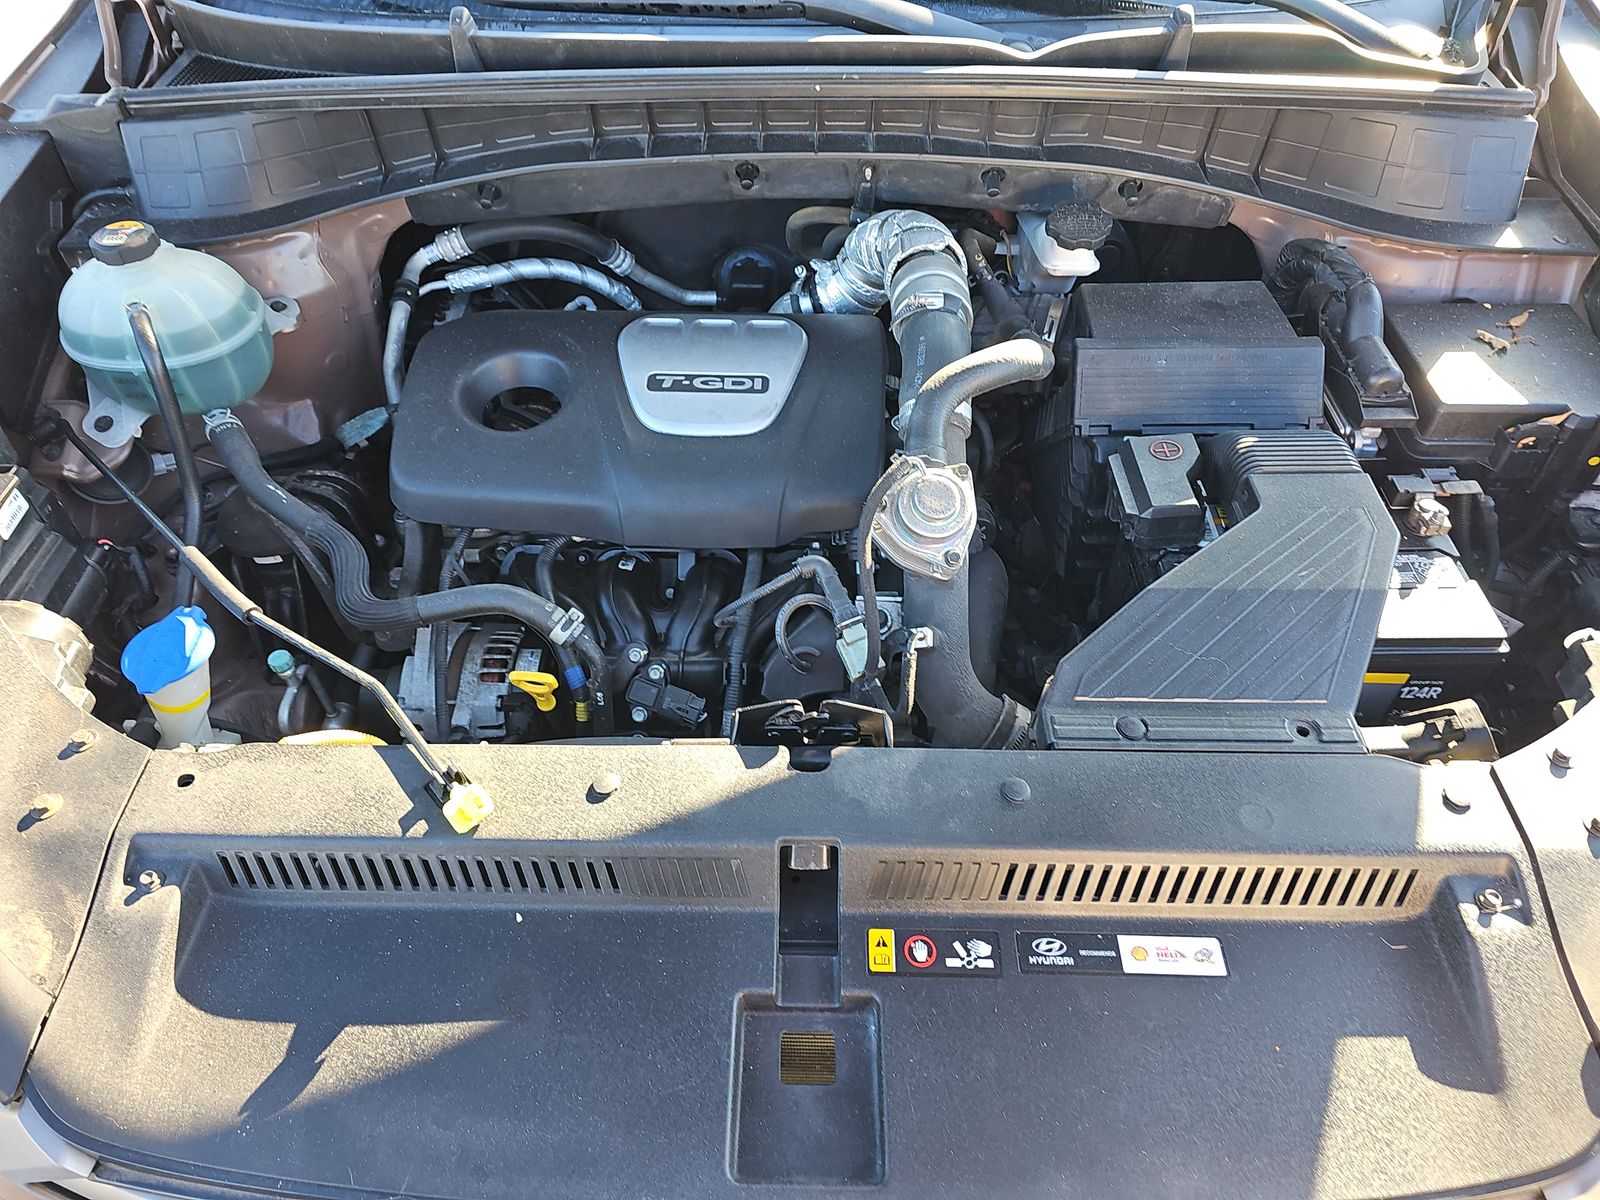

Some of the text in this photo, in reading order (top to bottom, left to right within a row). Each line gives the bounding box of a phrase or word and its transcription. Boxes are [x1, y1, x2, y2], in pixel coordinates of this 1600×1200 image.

[656, 375, 763, 390] T-GDI
[1400, 686, 1443, 699] 124R
[1028, 955, 1075, 966] HYUNDAI
